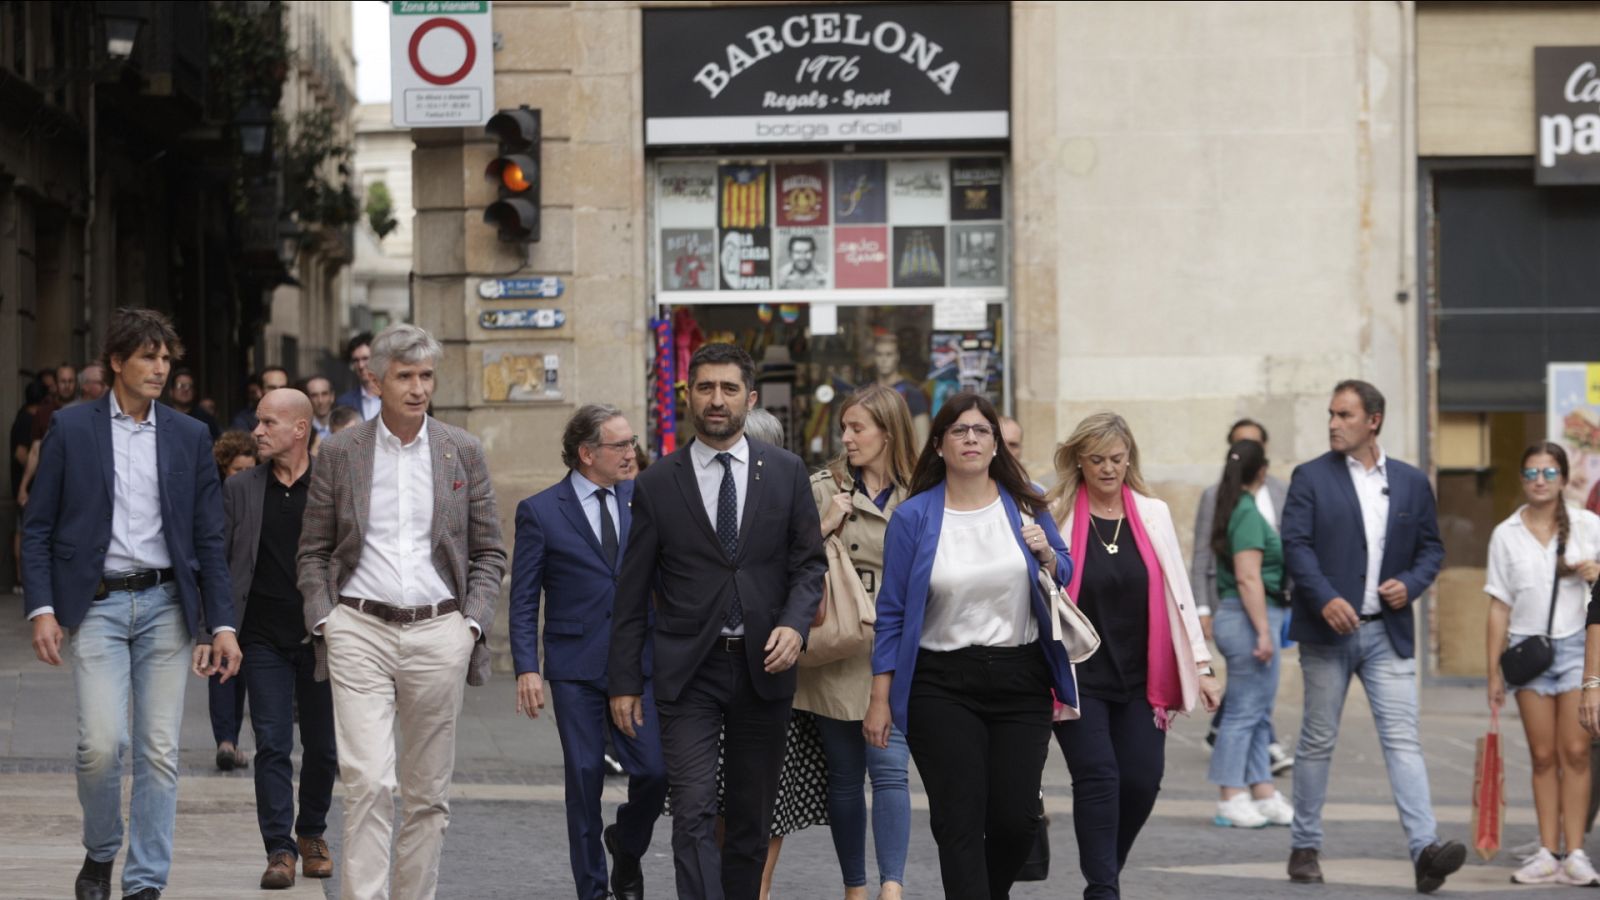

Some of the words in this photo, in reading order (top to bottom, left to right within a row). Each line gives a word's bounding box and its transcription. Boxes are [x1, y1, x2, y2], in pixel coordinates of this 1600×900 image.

[400, 1, 424, 12] Zona
[427, 1, 439, 11] de
[693, 13, 962, 99] BARCELONA
[795, 55, 861, 83] 1976
[762, 90, 829, 112] Regals
[842, 88, 892, 109] Sport
[756, 121, 830, 141] botiga
[838, 119, 902, 135] oficial
